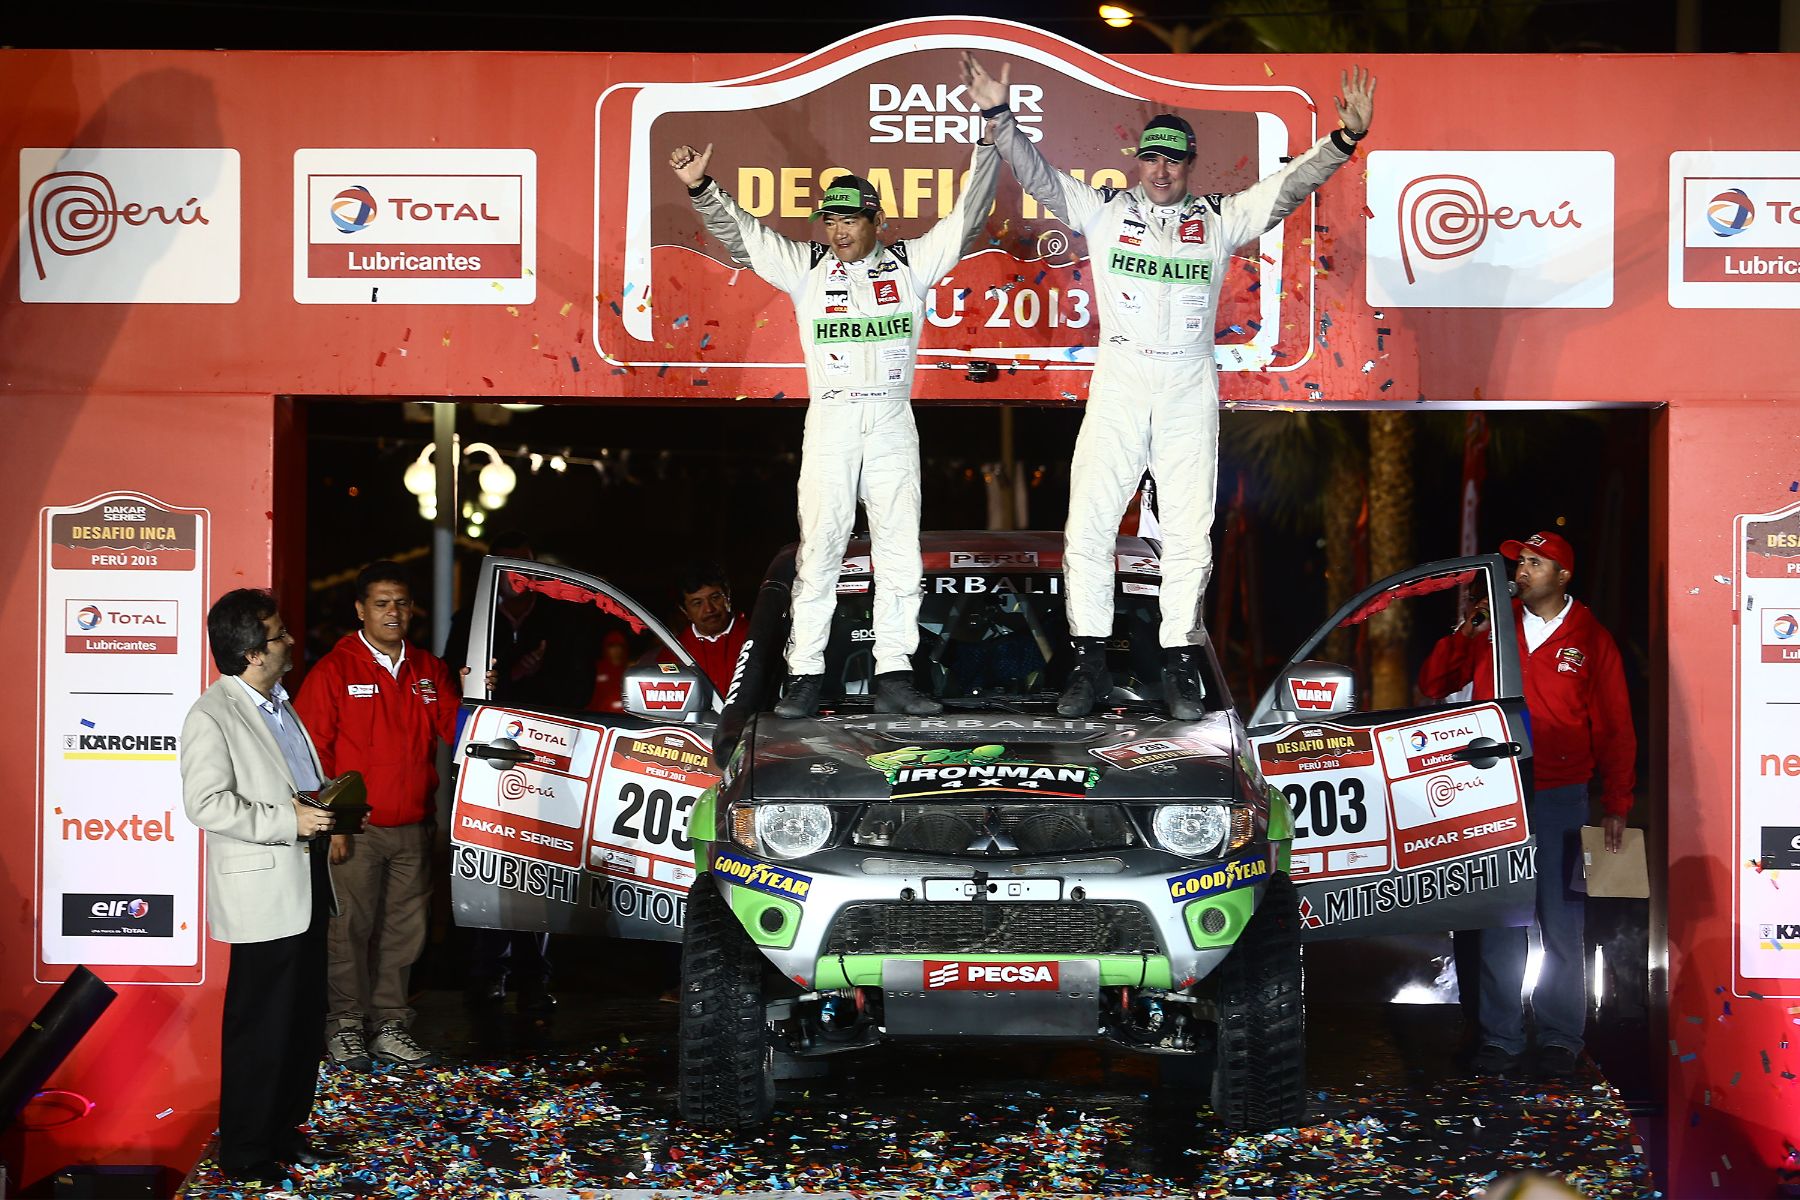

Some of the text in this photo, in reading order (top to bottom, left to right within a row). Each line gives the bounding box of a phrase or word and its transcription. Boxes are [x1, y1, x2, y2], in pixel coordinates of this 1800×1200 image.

[869, 83, 1044, 113] DAKR
[869, 115, 1044, 144] SERIS
[738, 166, 996, 219] DEAFI
[388, 197, 500, 222] TOTAL
[29, 170, 209, 280] Perú
[1398, 174, 1582, 285] Perú
[347, 251, 482, 272] Lubricantes
[1111, 253, 1210, 281] HERBALIFE
[1724, 255, 1800, 275] Lubric
[983, 288, 1091, 328] 2013
[816, 317, 911, 339] HERBALIFE
[103, 506, 146, 514] DAKAR
[103, 513, 146, 521] SERIES
[72, 526, 176, 540] DESAFIO INCA
[91, 553, 158, 566] PERÚ 2013
[107, 612, 167, 624] TOTAL
[86, 639, 157, 651] Lubricantes
[646, 689, 685, 702] WARN
[1296, 688, 1332, 702] WARN
[527, 727, 568, 747] TOTAL
[1431, 726, 1474, 742] TOTAL
[632, 740, 680, 761] DESAFIO
[680, 751, 709, 768] INCA
[1276, 736, 1355, 755] DESAFIO INCA
[898, 765, 1086, 783] IRONMAN
[1298, 759, 1340, 771] PERÚ 2013
[941, 780, 964, 788] 4
[1018, 780, 1040, 788] 4
[611, 782, 698, 852] 203
[1281, 777, 1367, 838] 203
[62, 811, 175, 842] nextel
[461, 816, 574, 852] DAKAR SERIES
[1404, 817, 1517, 853] DAKAR SERIES
[1324, 854, 1500, 925] MITSUBISHI
[91, 900, 128, 917] elf
[968, 965, 1053, 983] PECSA
